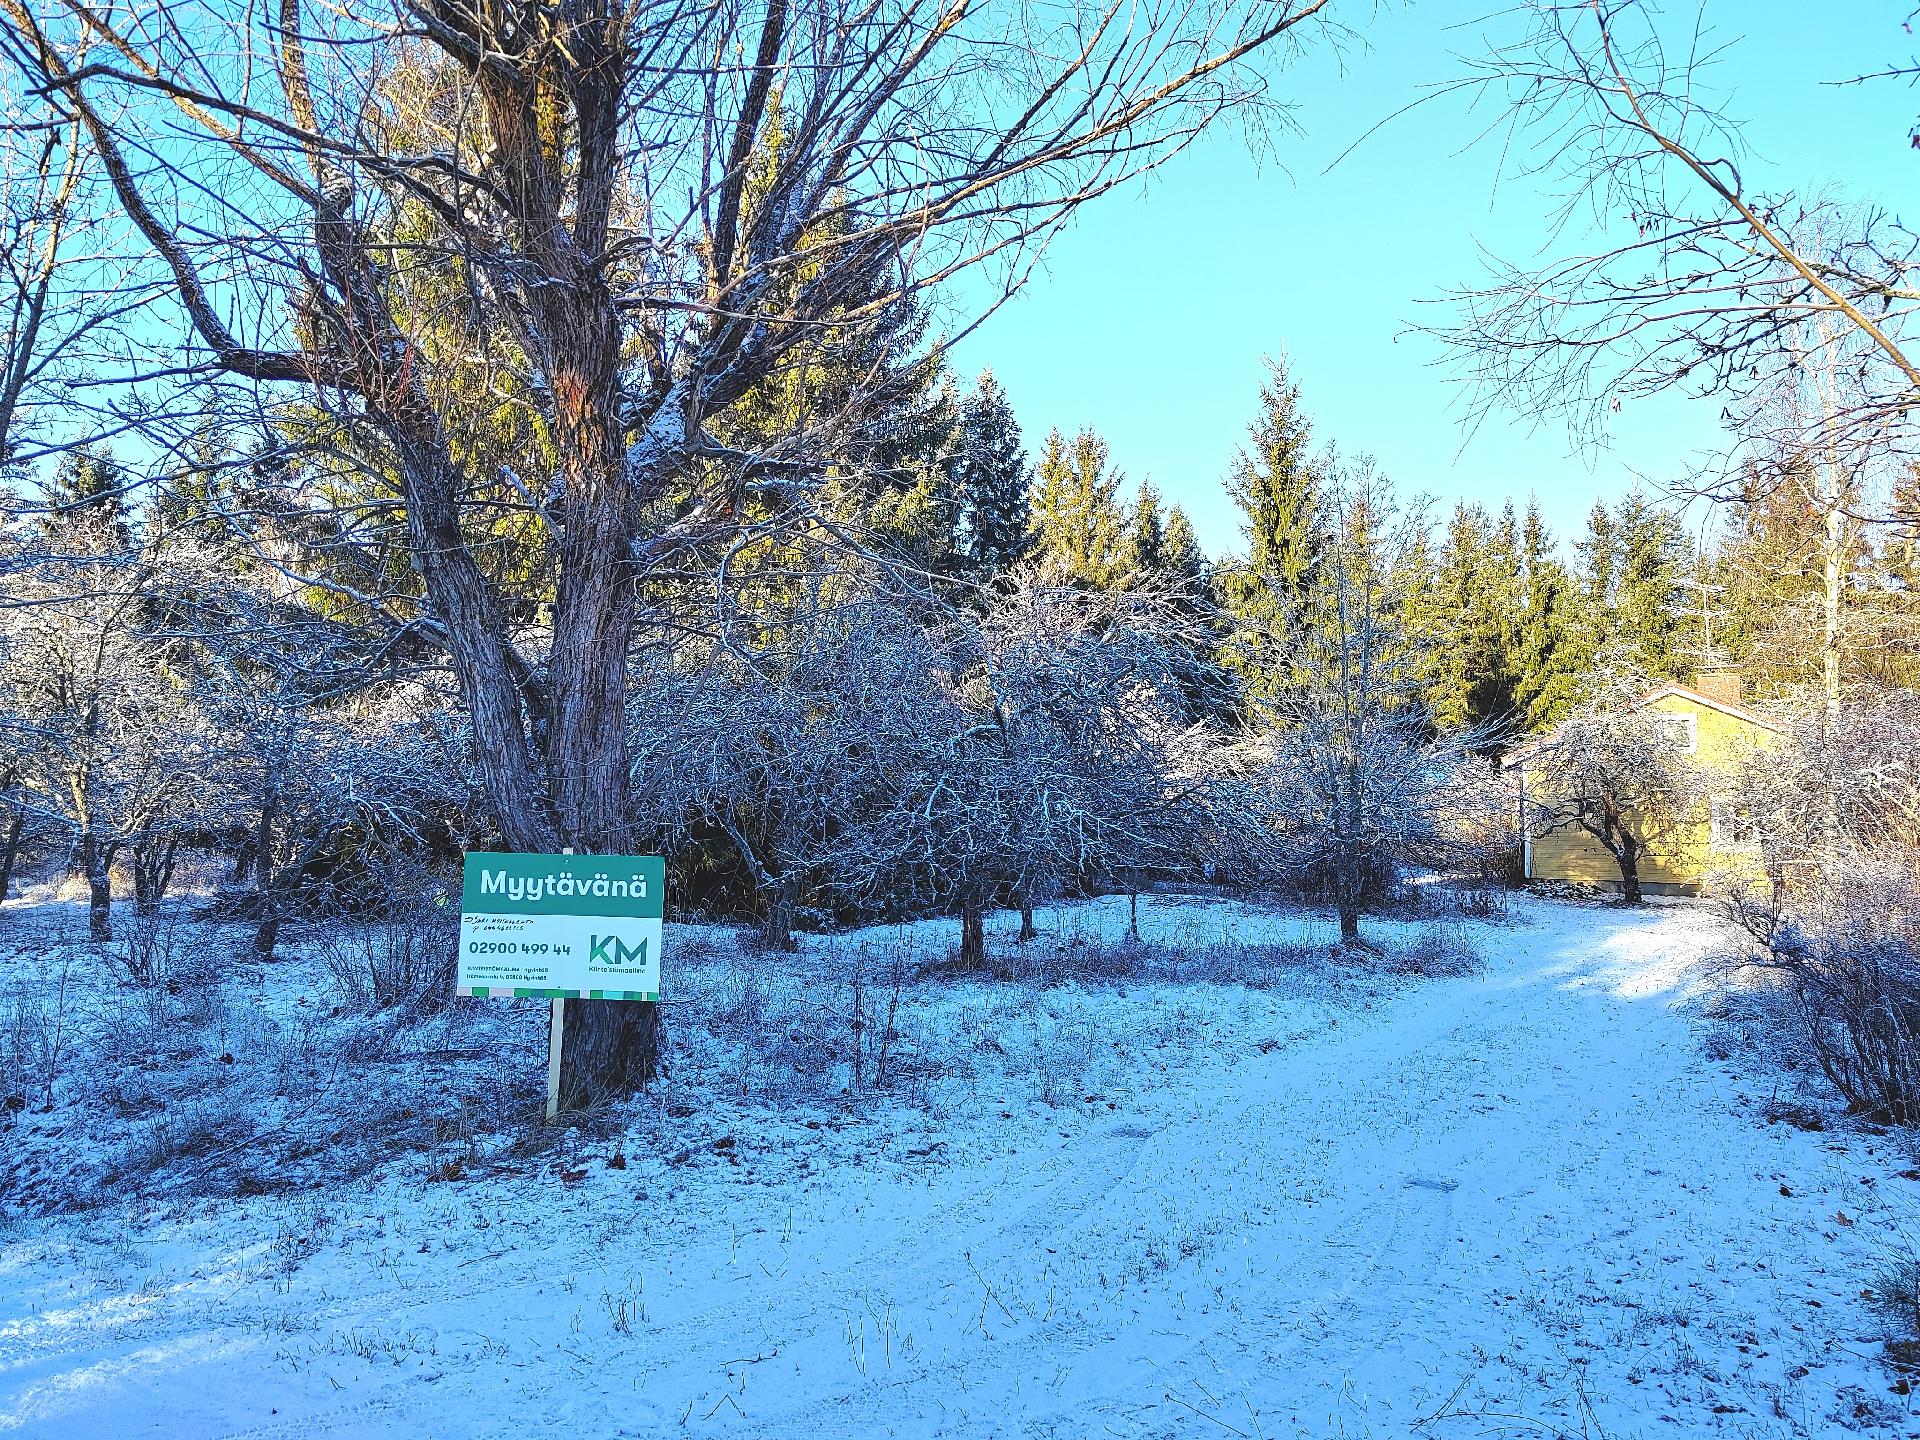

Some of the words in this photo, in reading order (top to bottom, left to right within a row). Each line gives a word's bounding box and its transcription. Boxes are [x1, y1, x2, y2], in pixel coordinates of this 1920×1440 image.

[480, 869, 647, 901] Myytävänä
[468, 941, 518, 954] 02900
[521, 943, 549, 955] 499
[553, 944, 571, 956] 44
[589, 934, 648, 966] KM
